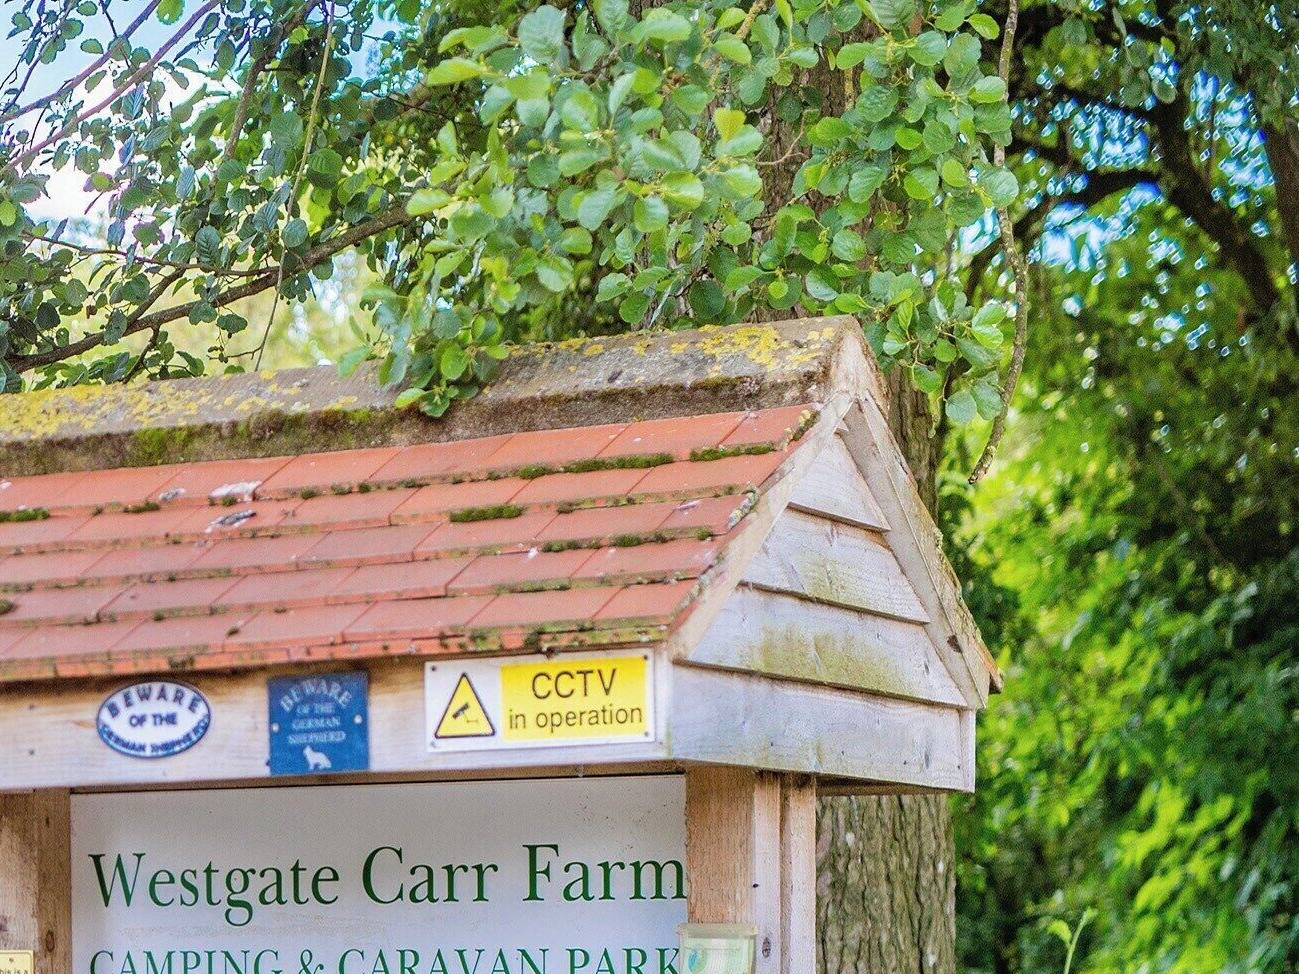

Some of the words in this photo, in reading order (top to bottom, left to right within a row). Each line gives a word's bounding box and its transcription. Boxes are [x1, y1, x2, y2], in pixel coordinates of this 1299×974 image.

[281, 679, 352, 712] BEWARE
[532, 668, 617, 700] CCTV
[106, 684, 202, 718] BEWARE
[129, 714, 146, 727] OF
[152, 711, 177, 726] THE
[509, 709, 527, 730] in
[536, 703, 643, 733] operation
[88, 852, 340, 927] Westgate
[362, 846, 499, 904] Carr
[522, 843, 688, 901] Farm
